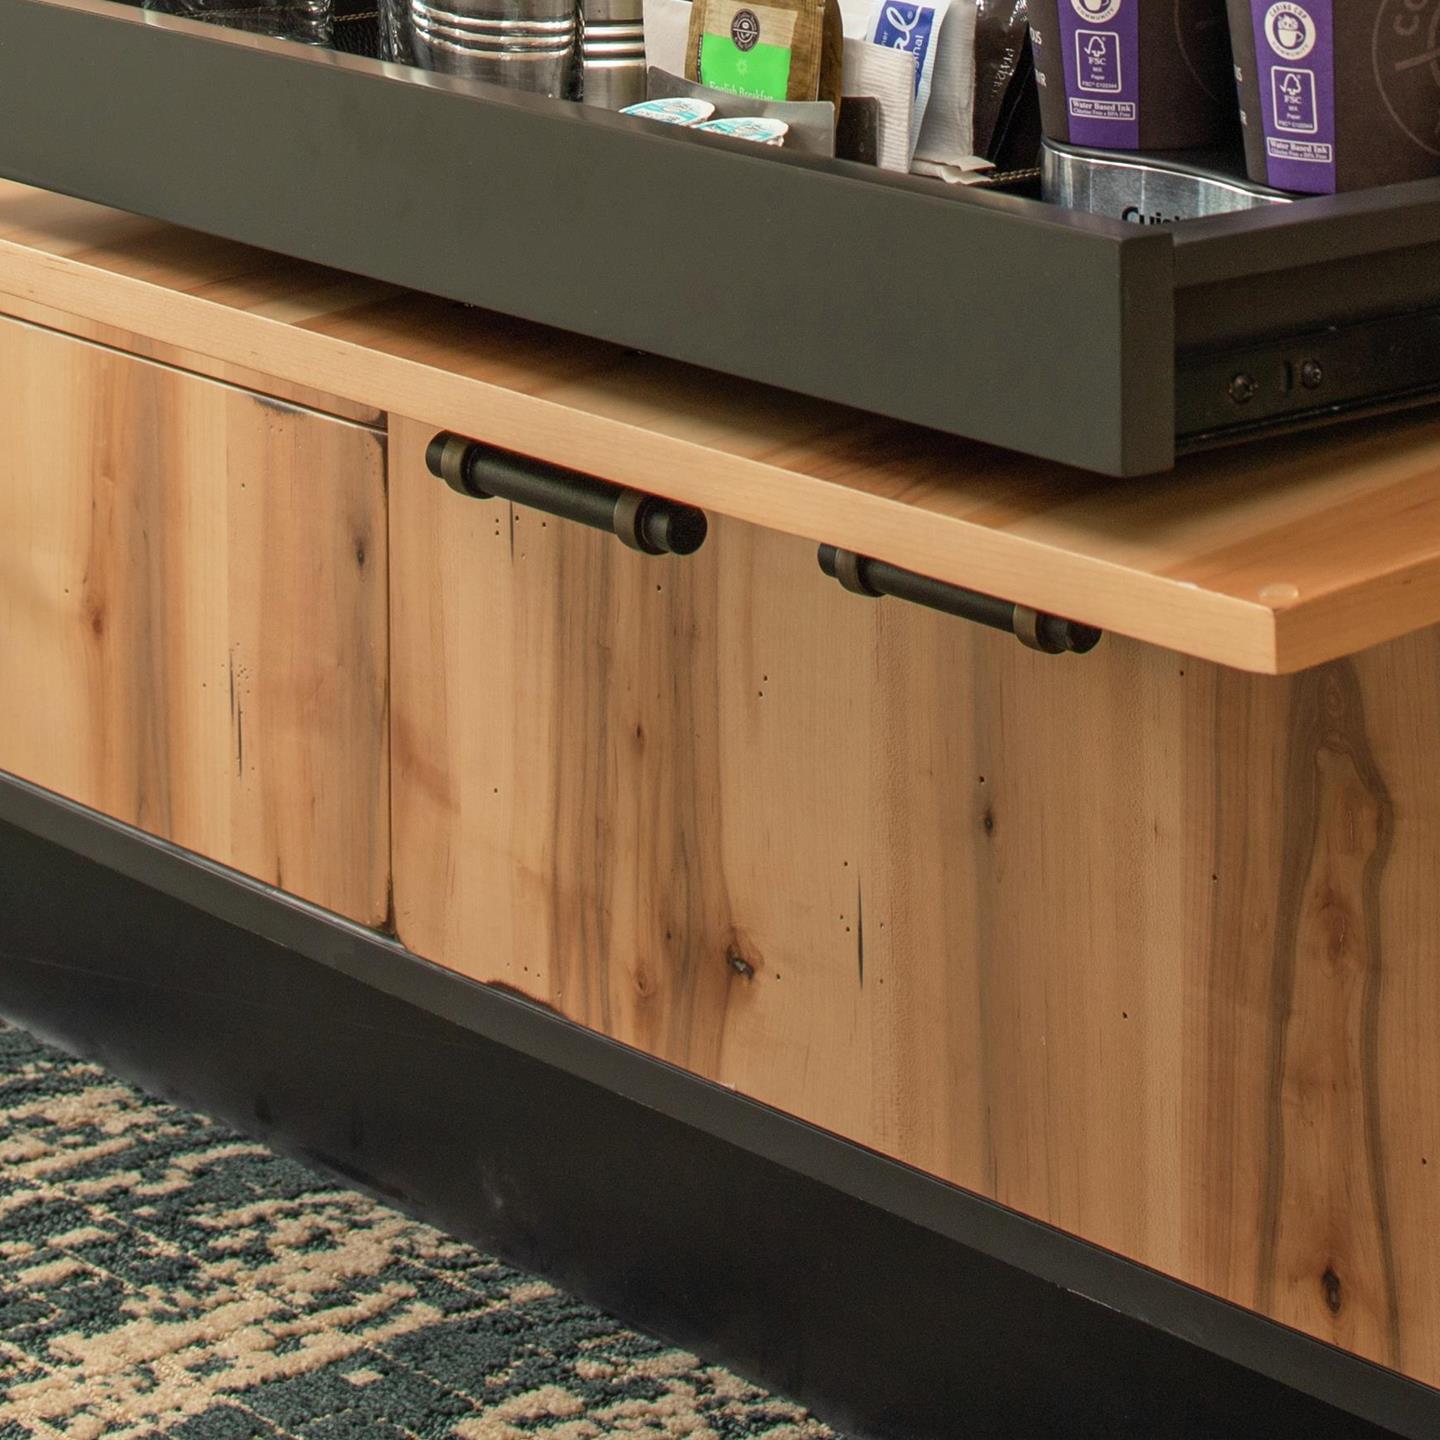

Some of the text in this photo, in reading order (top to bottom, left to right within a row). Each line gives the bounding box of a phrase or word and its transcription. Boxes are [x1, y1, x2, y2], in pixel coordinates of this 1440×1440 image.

[1088, 56, 1107, 66] FSC
[1283, 95, 1302, 105] FSC
[1072, 100, 1131, 112] Water Based Ink
[1270, 139, 1289, 149] Water
